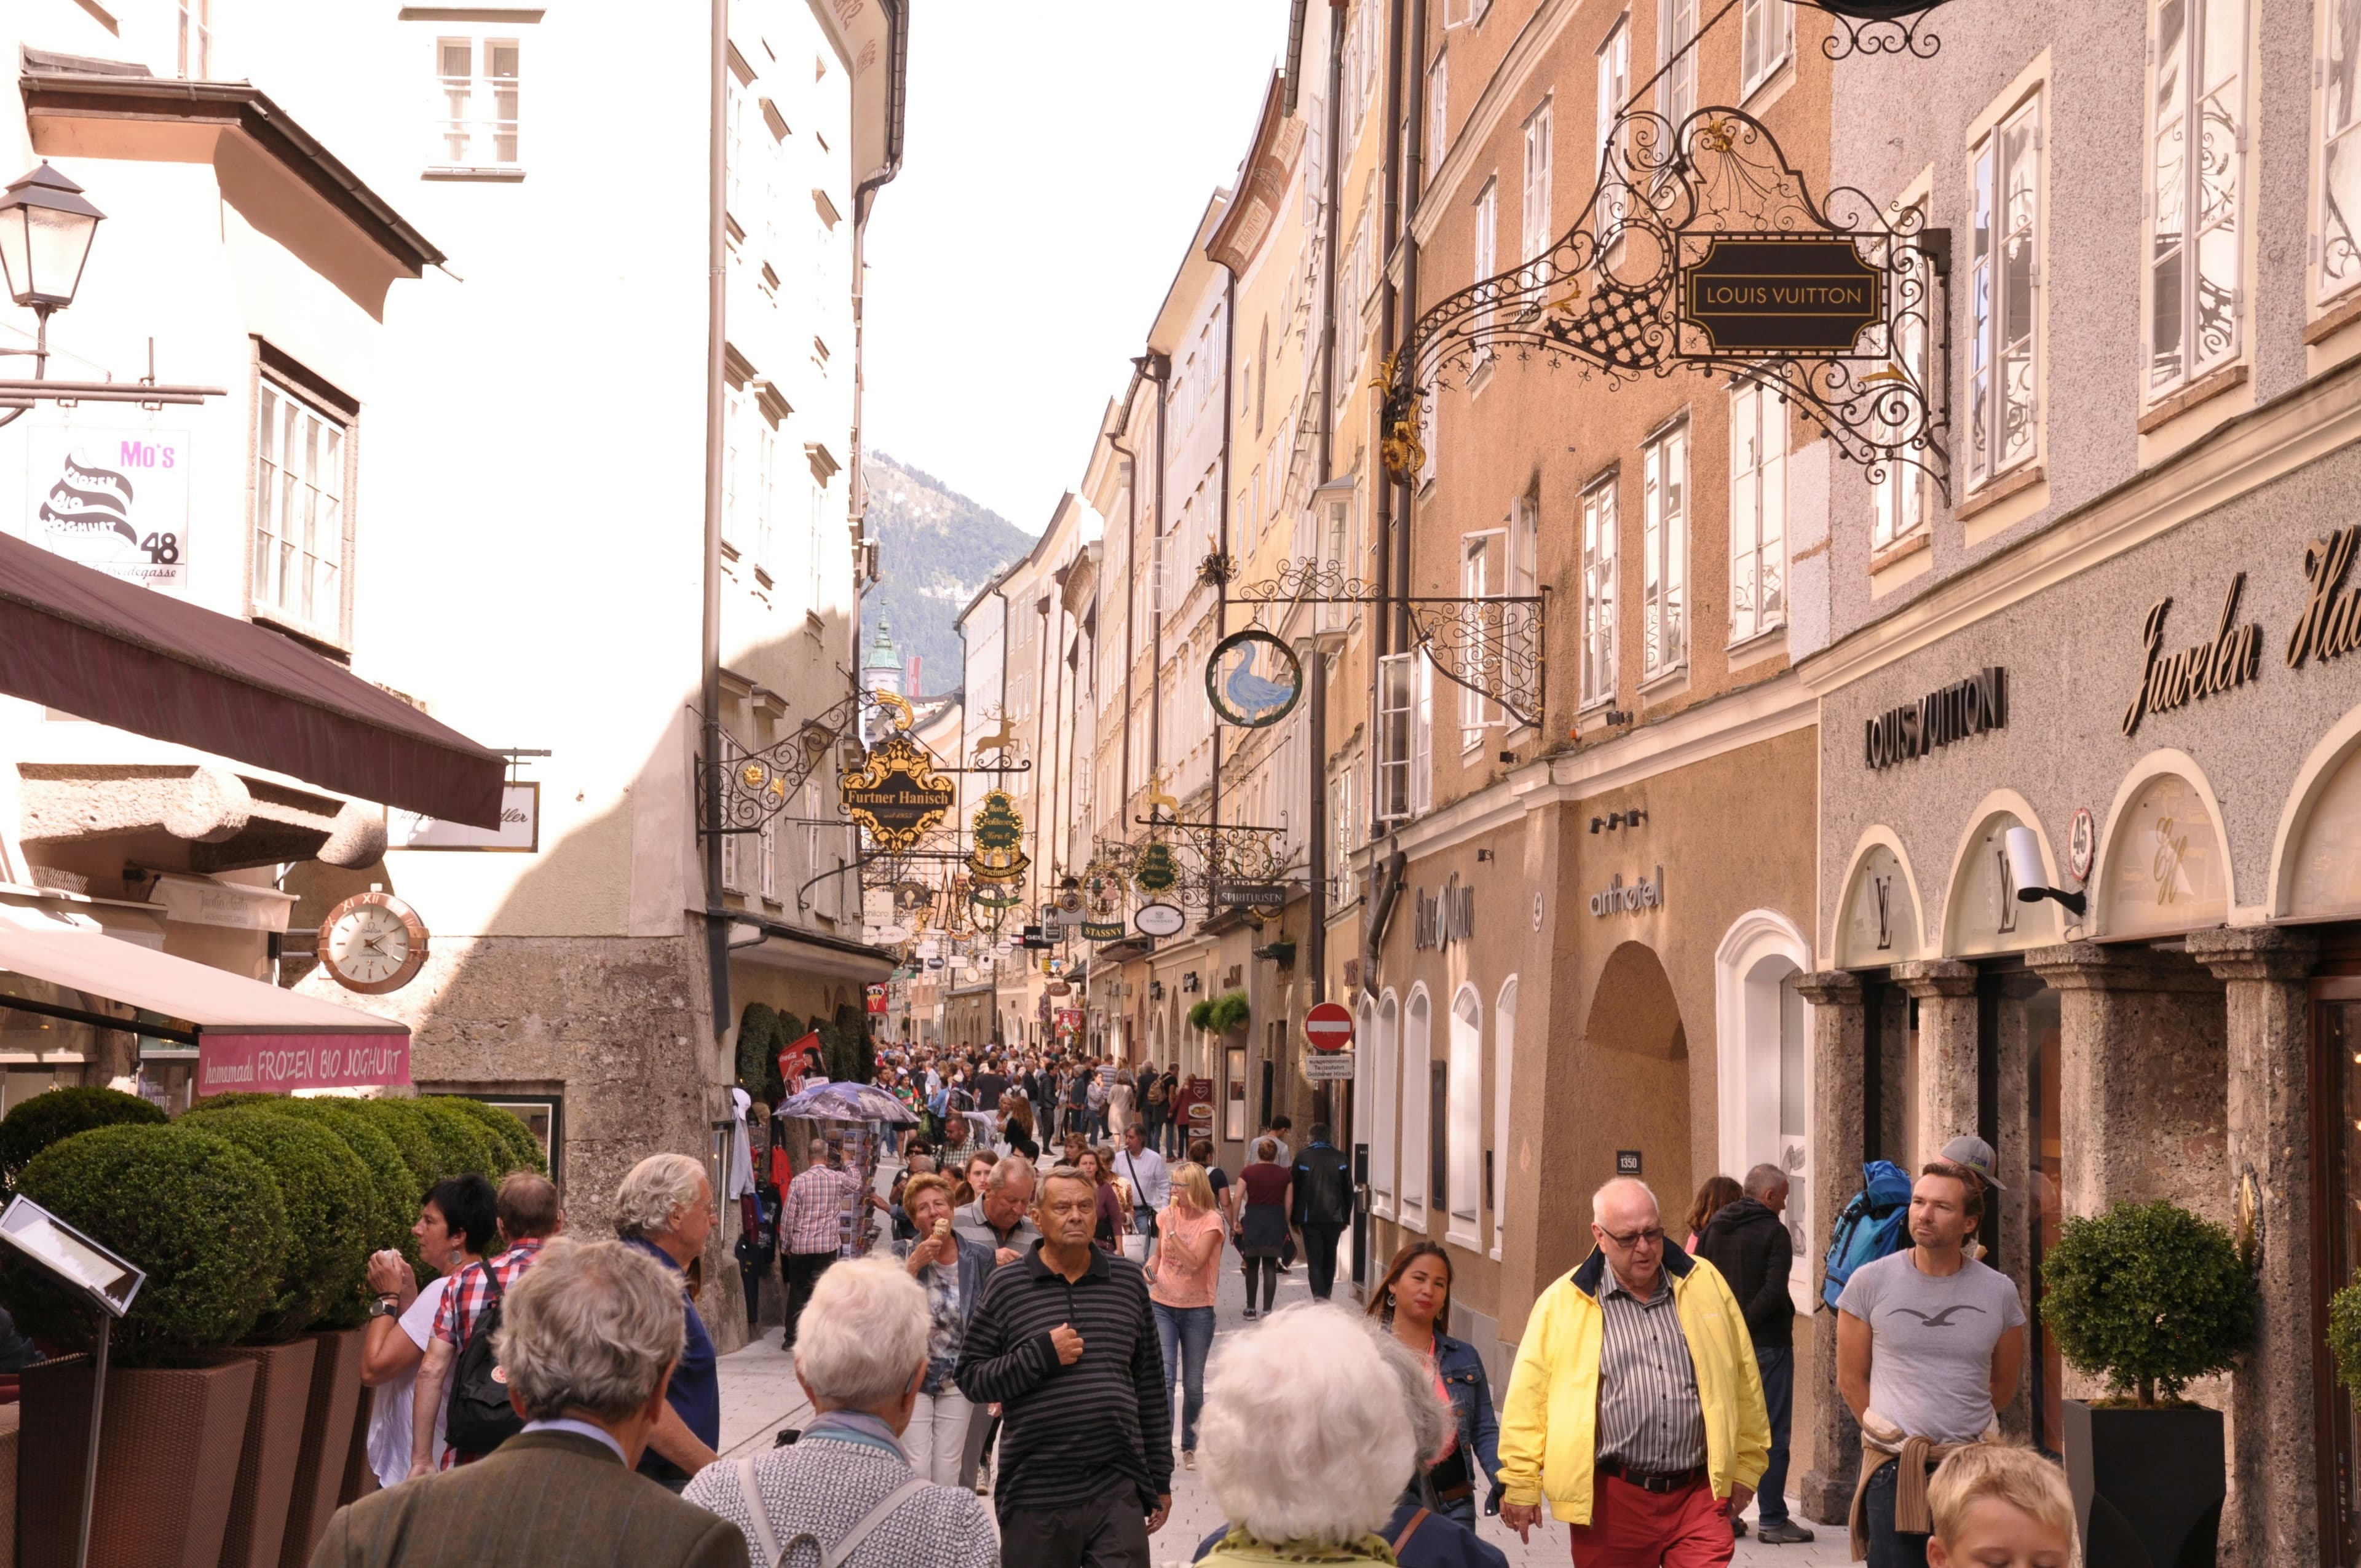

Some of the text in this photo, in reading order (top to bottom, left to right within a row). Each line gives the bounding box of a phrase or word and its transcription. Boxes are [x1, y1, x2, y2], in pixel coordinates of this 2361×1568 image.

[1707, 287, 1861, 304] LOUIS VUITTON
[120, 440, 175, 469] Mo's
[65, 465, 117, 488] FROZEN
[43, 512, 116, 533] JOGHURT
[141, 532, 179, 564] 48
[2122, 571, 2264, 736] Juwelen
[1865, 666, 2007, 770] LOUIS VUITTON
[848, 790, 949, 805] Furtner Hanisch
[2073, 815, 2087, 855] 45
[362, 894, 379, 905] XII
[1221, 893, 1283, 903] SPIRITUOSEN
[1590, 865, 1663, 916] arthotel
[1085, 926, 1123, 938] STASSNY
[205, 1046, 401, 1084] homemade FROZEN BIO JOGHURT
[1620, 1157, 1637, 1169] 1350
